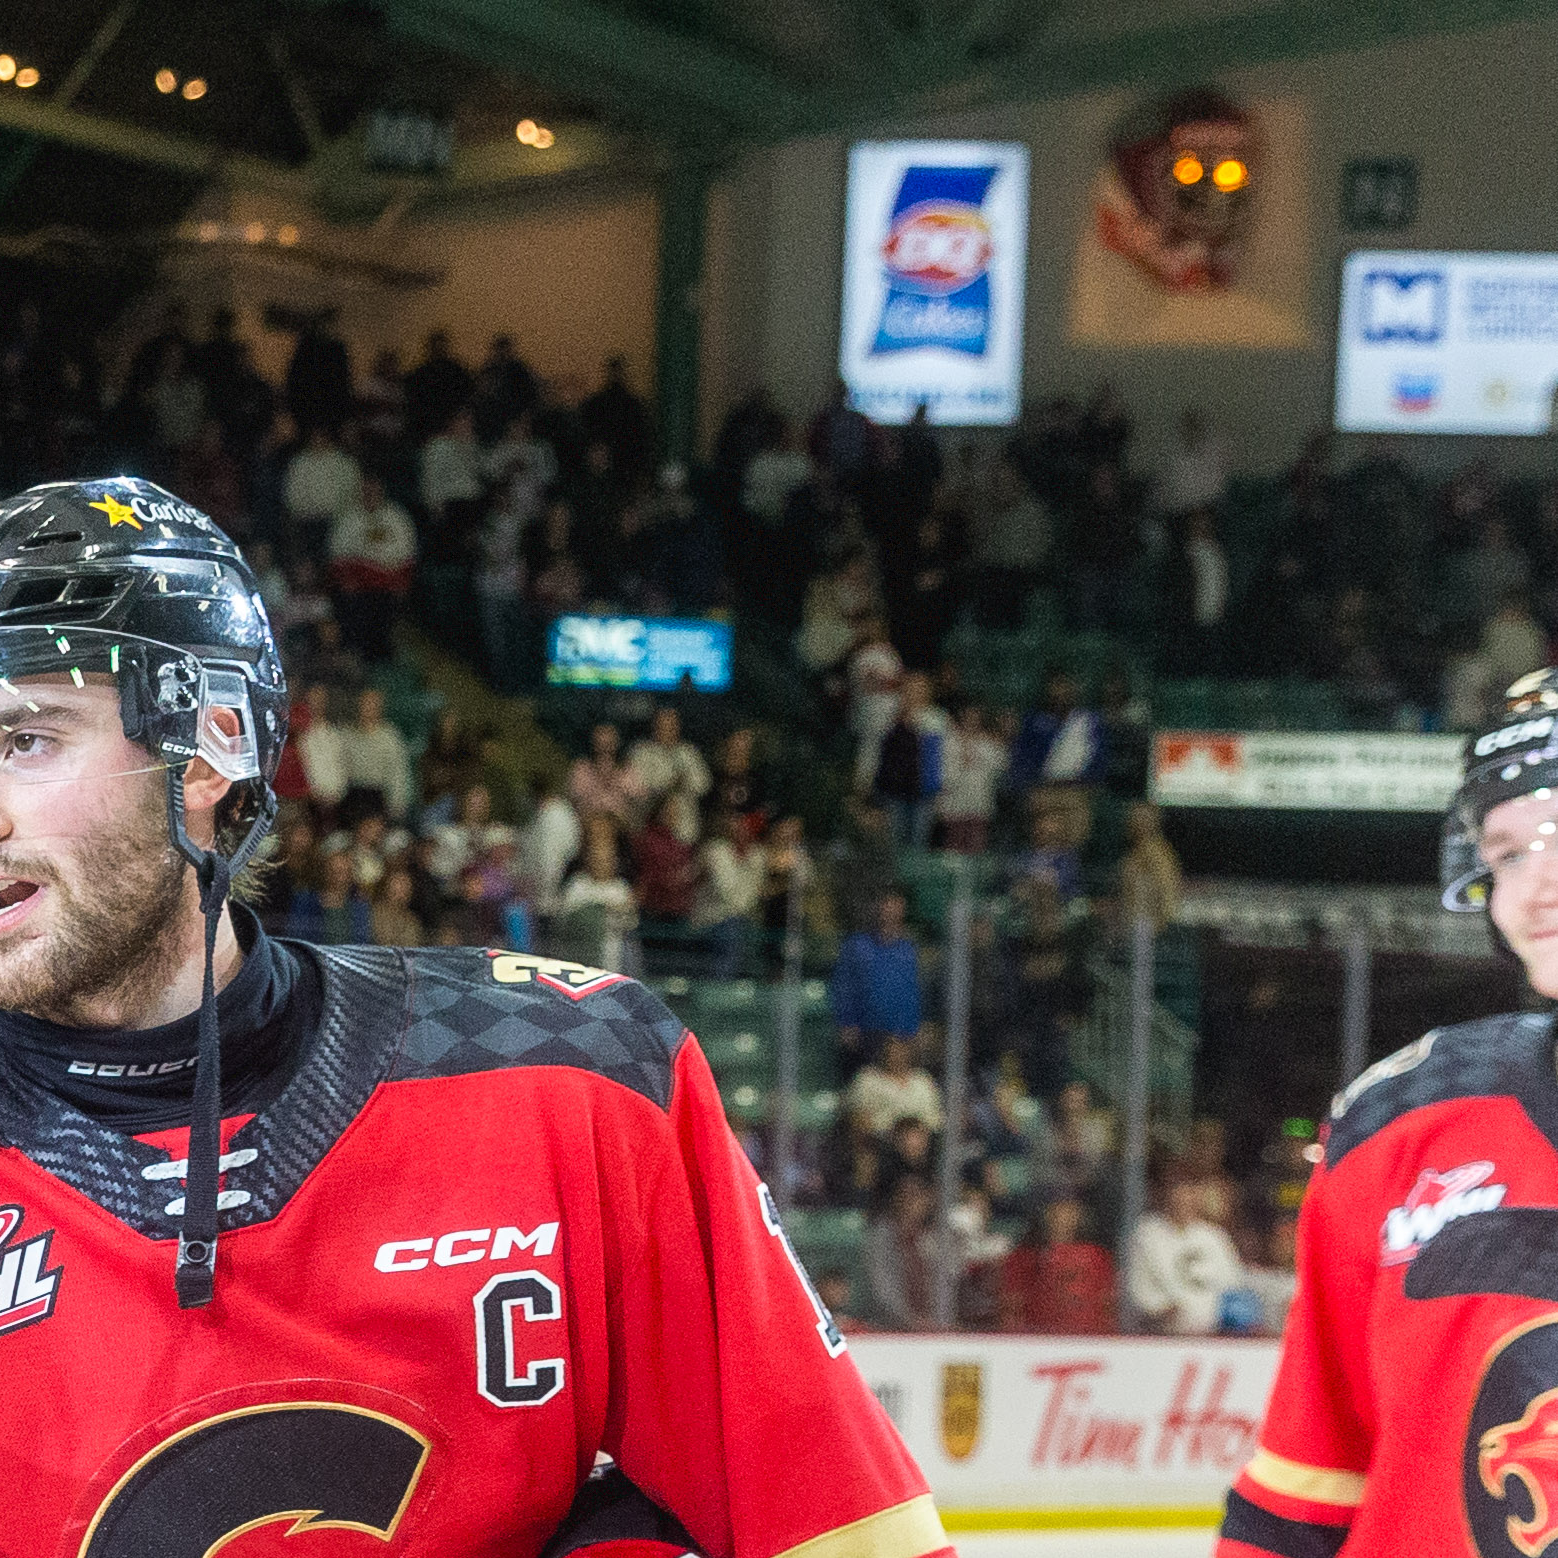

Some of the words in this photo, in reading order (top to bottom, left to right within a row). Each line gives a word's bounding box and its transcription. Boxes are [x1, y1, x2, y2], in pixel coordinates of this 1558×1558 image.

[160, 738, 197, 759] CCM
[373, 1221, 560, 1274] CCM
[472, 1269, 565, 1408] C
[1030, 1359, 1146, 1470] Tim
